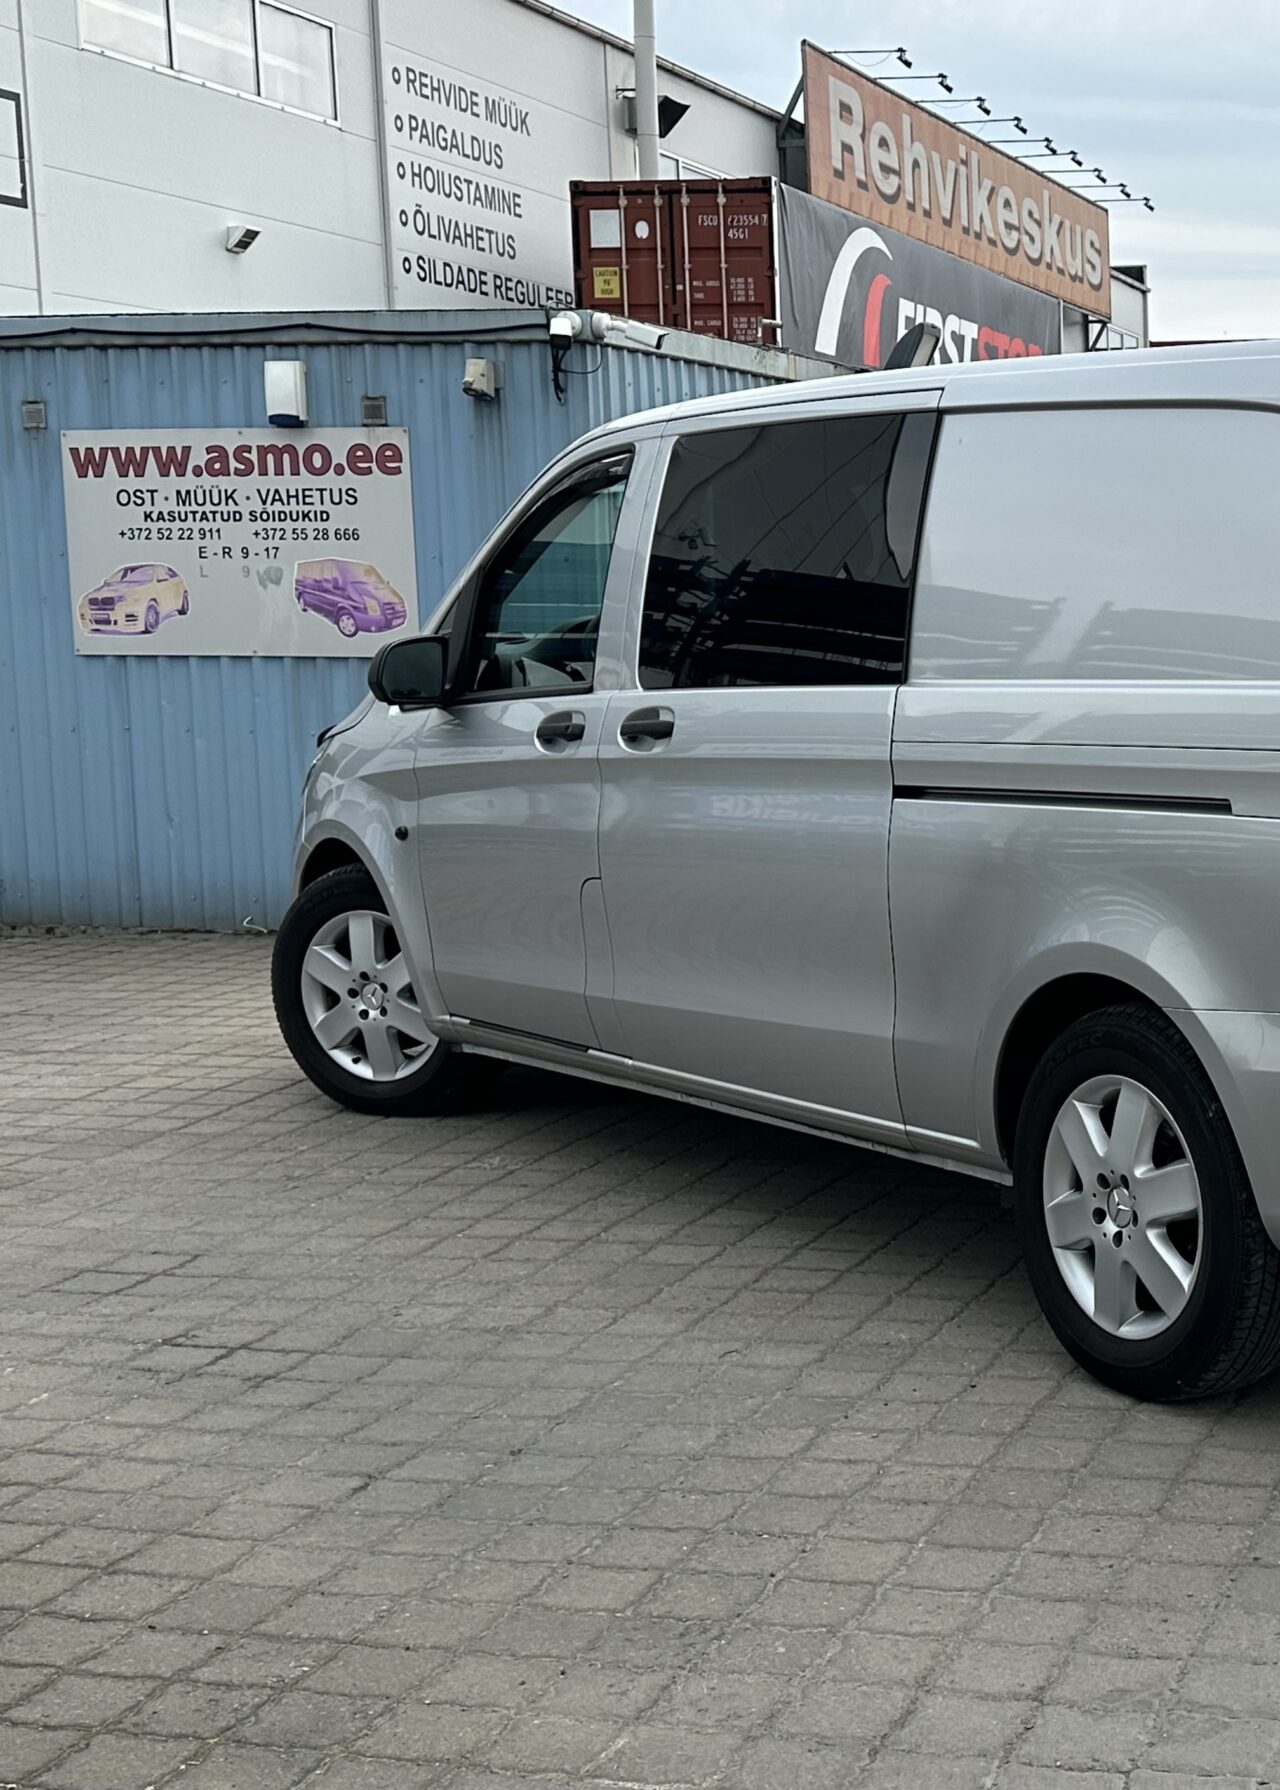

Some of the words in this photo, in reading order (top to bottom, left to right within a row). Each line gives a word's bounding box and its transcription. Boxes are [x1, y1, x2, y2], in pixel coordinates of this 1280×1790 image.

[405, 66, 480, 119] REHVIDE
[484, 95, 531, 136] MÜÜK
[408, 113, 504, 170] PAIGALDUS
[410, 160, 523, 218] HOIUSTAMINE
[828, 75, 1103, 291] Rehvikeskus
[413, 203, 517, 260] ÕLIVAHETUS
[697, 215, 719, 226] FSCU
[727, 228, 749, 239] 45G1
[416, 254, 489, 297] SILDADE
[69, 442, 404, 478] www.asmo.ee
[116, 489, 158, 507] OST
[175, 485, 239, 507] MÜÜK
[256, 487, 359, 507] VAHETUS
[143, 510, 243, 523] KASUTATUD
[248, 508, 331, 523] SÕIDUKID
[118, 528, 152, 541] +372
[156, 528, 174, 541] 52
[177, 528, 194, 541] 22
[199, 528, 222, 541] 911
[252, 528, 287, 541] +372
[291, 528, 309, 541] 55
[313, 528, 330, 541] 28
[334, 527, 360, 541] 666
